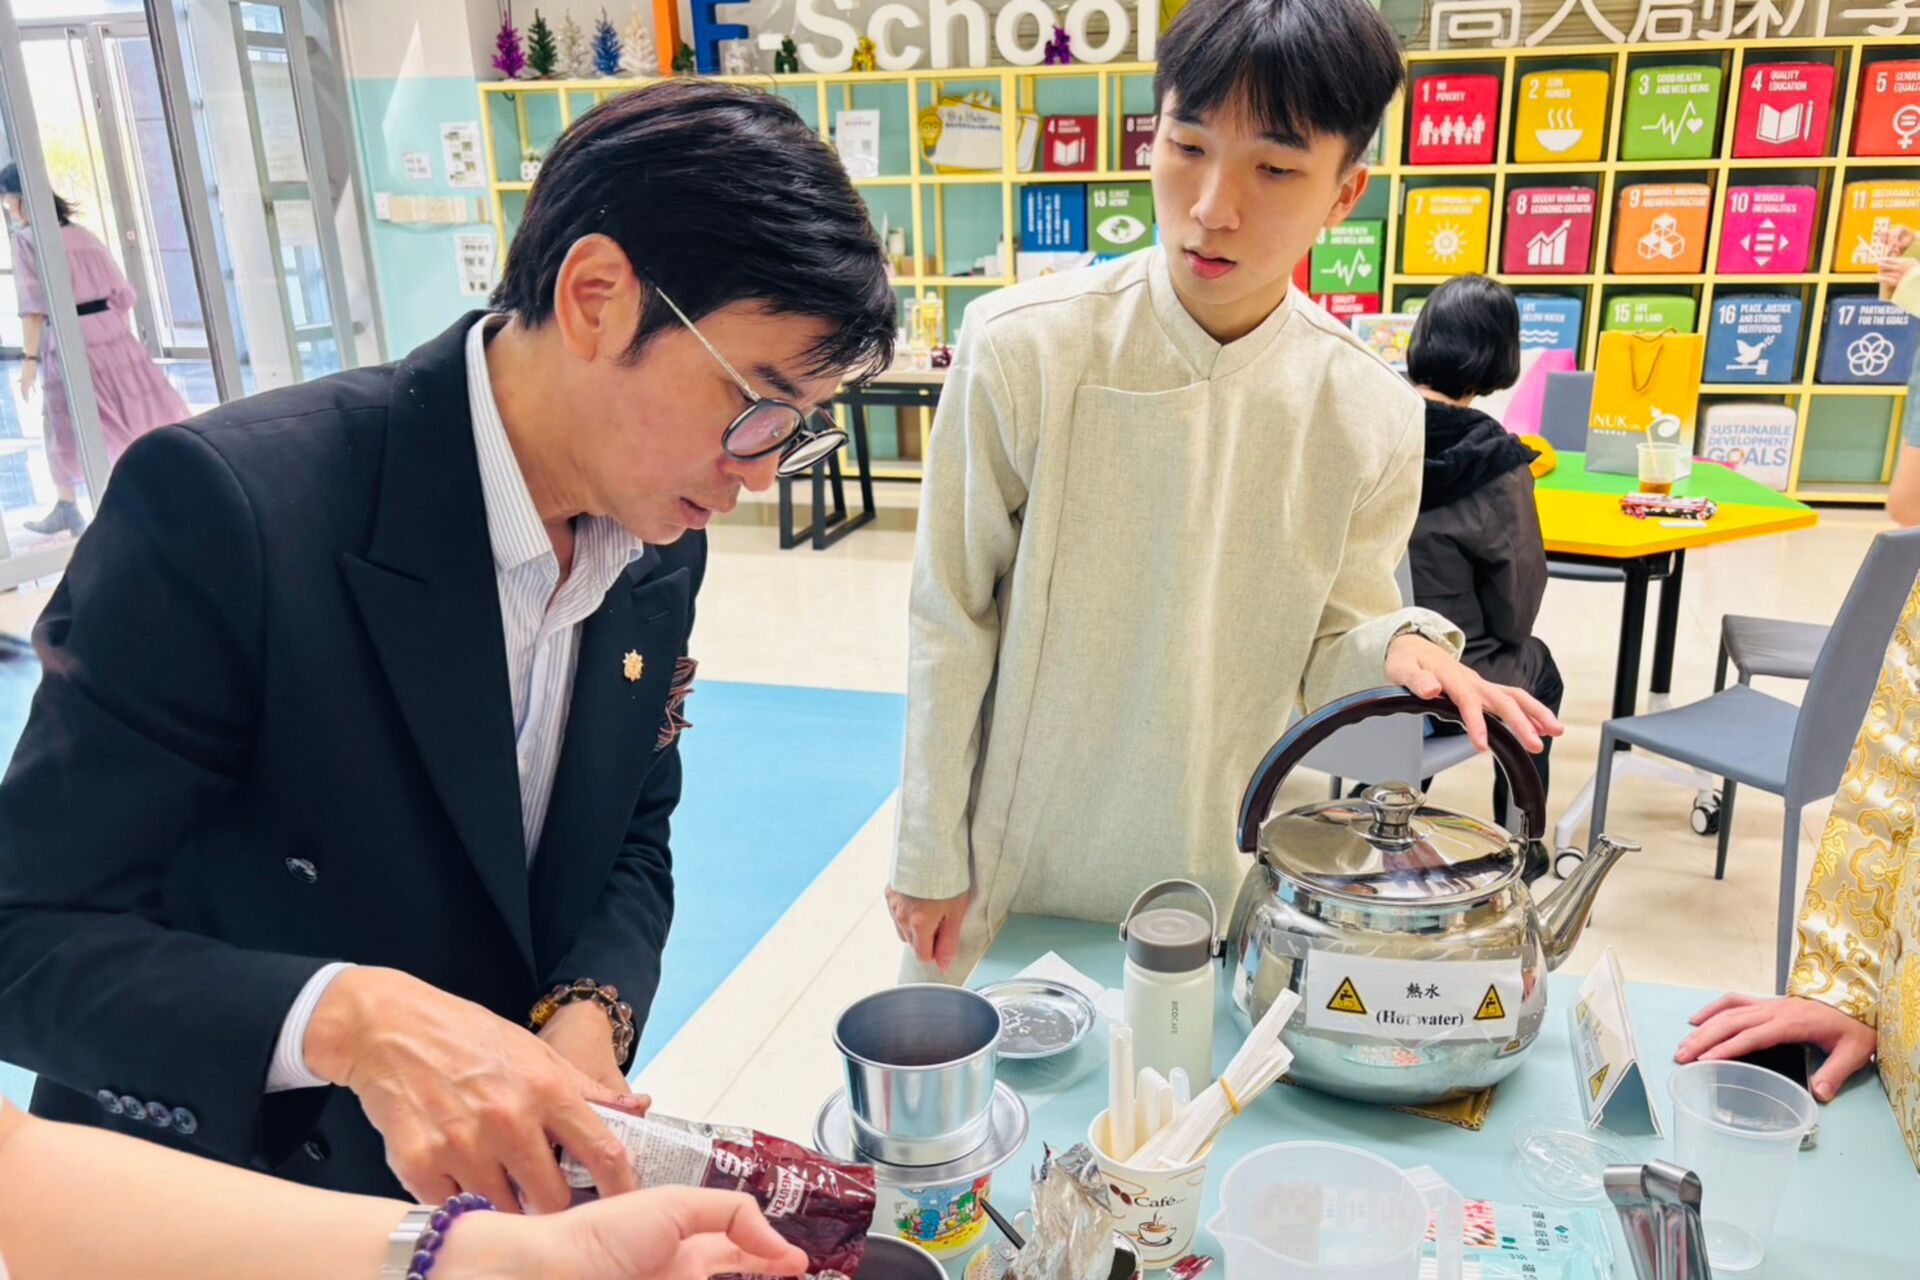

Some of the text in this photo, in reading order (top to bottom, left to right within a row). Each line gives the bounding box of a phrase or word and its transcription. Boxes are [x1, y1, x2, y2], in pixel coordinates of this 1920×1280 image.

[1529, 79, 1540, 99] 2
[1639, 75, 1650, 96] 3
[1751, 70, 1764, 91] 4
[1876, 72, 1888, 93] 5
[1422, 81, 1430, 103] 1
[1415, 196, 1424, 216] 7
[1516, 195, 1527, 215] 8
[1629, 189, 1640, 209] 9
[1730, 193, 1749, 214] 10
[1614, 304, 1630, 323] 15
[1719, 304, 1736, 325] 16
[1839, 305, 1856, 326] 17
[1594, 414, 1628, 430] NUK
[1710, 424, 1793, 436] SUSTAINABLE
[1708, 435, 1789, 447] DEVELOPMENT
[1707, 446, 1788, 466] GOALS
[1406, 982, 1441, 999] 熱水
[1134, 1195, 1177, 1208] Café
